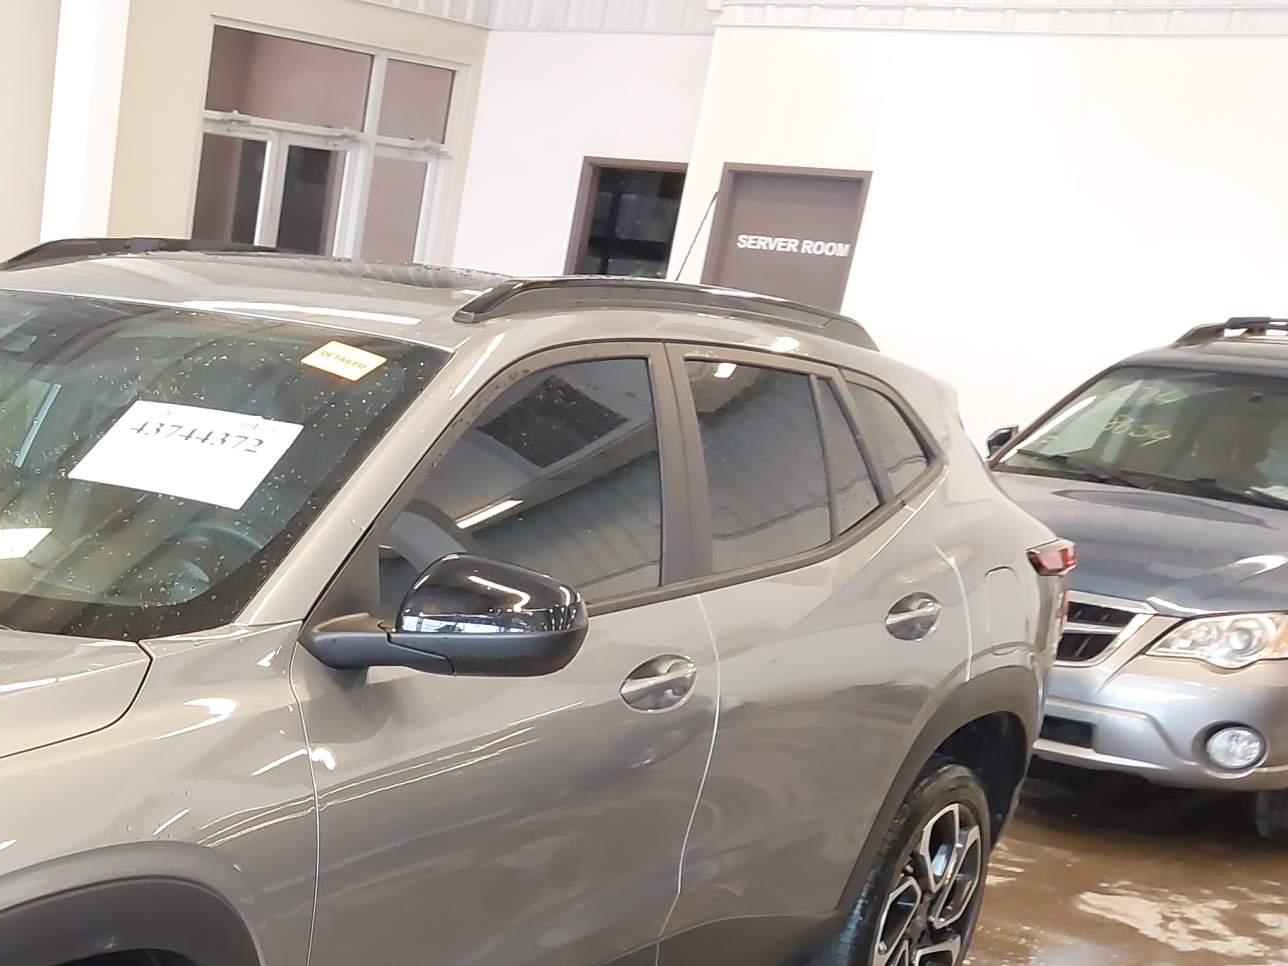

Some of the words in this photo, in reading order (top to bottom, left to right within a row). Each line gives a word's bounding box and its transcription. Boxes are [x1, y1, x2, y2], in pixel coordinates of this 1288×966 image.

[737, 235, 799, 252] SERVER
[801, 240, 850, 256] ROOM
[131, 421, 263, 452] 43744372
